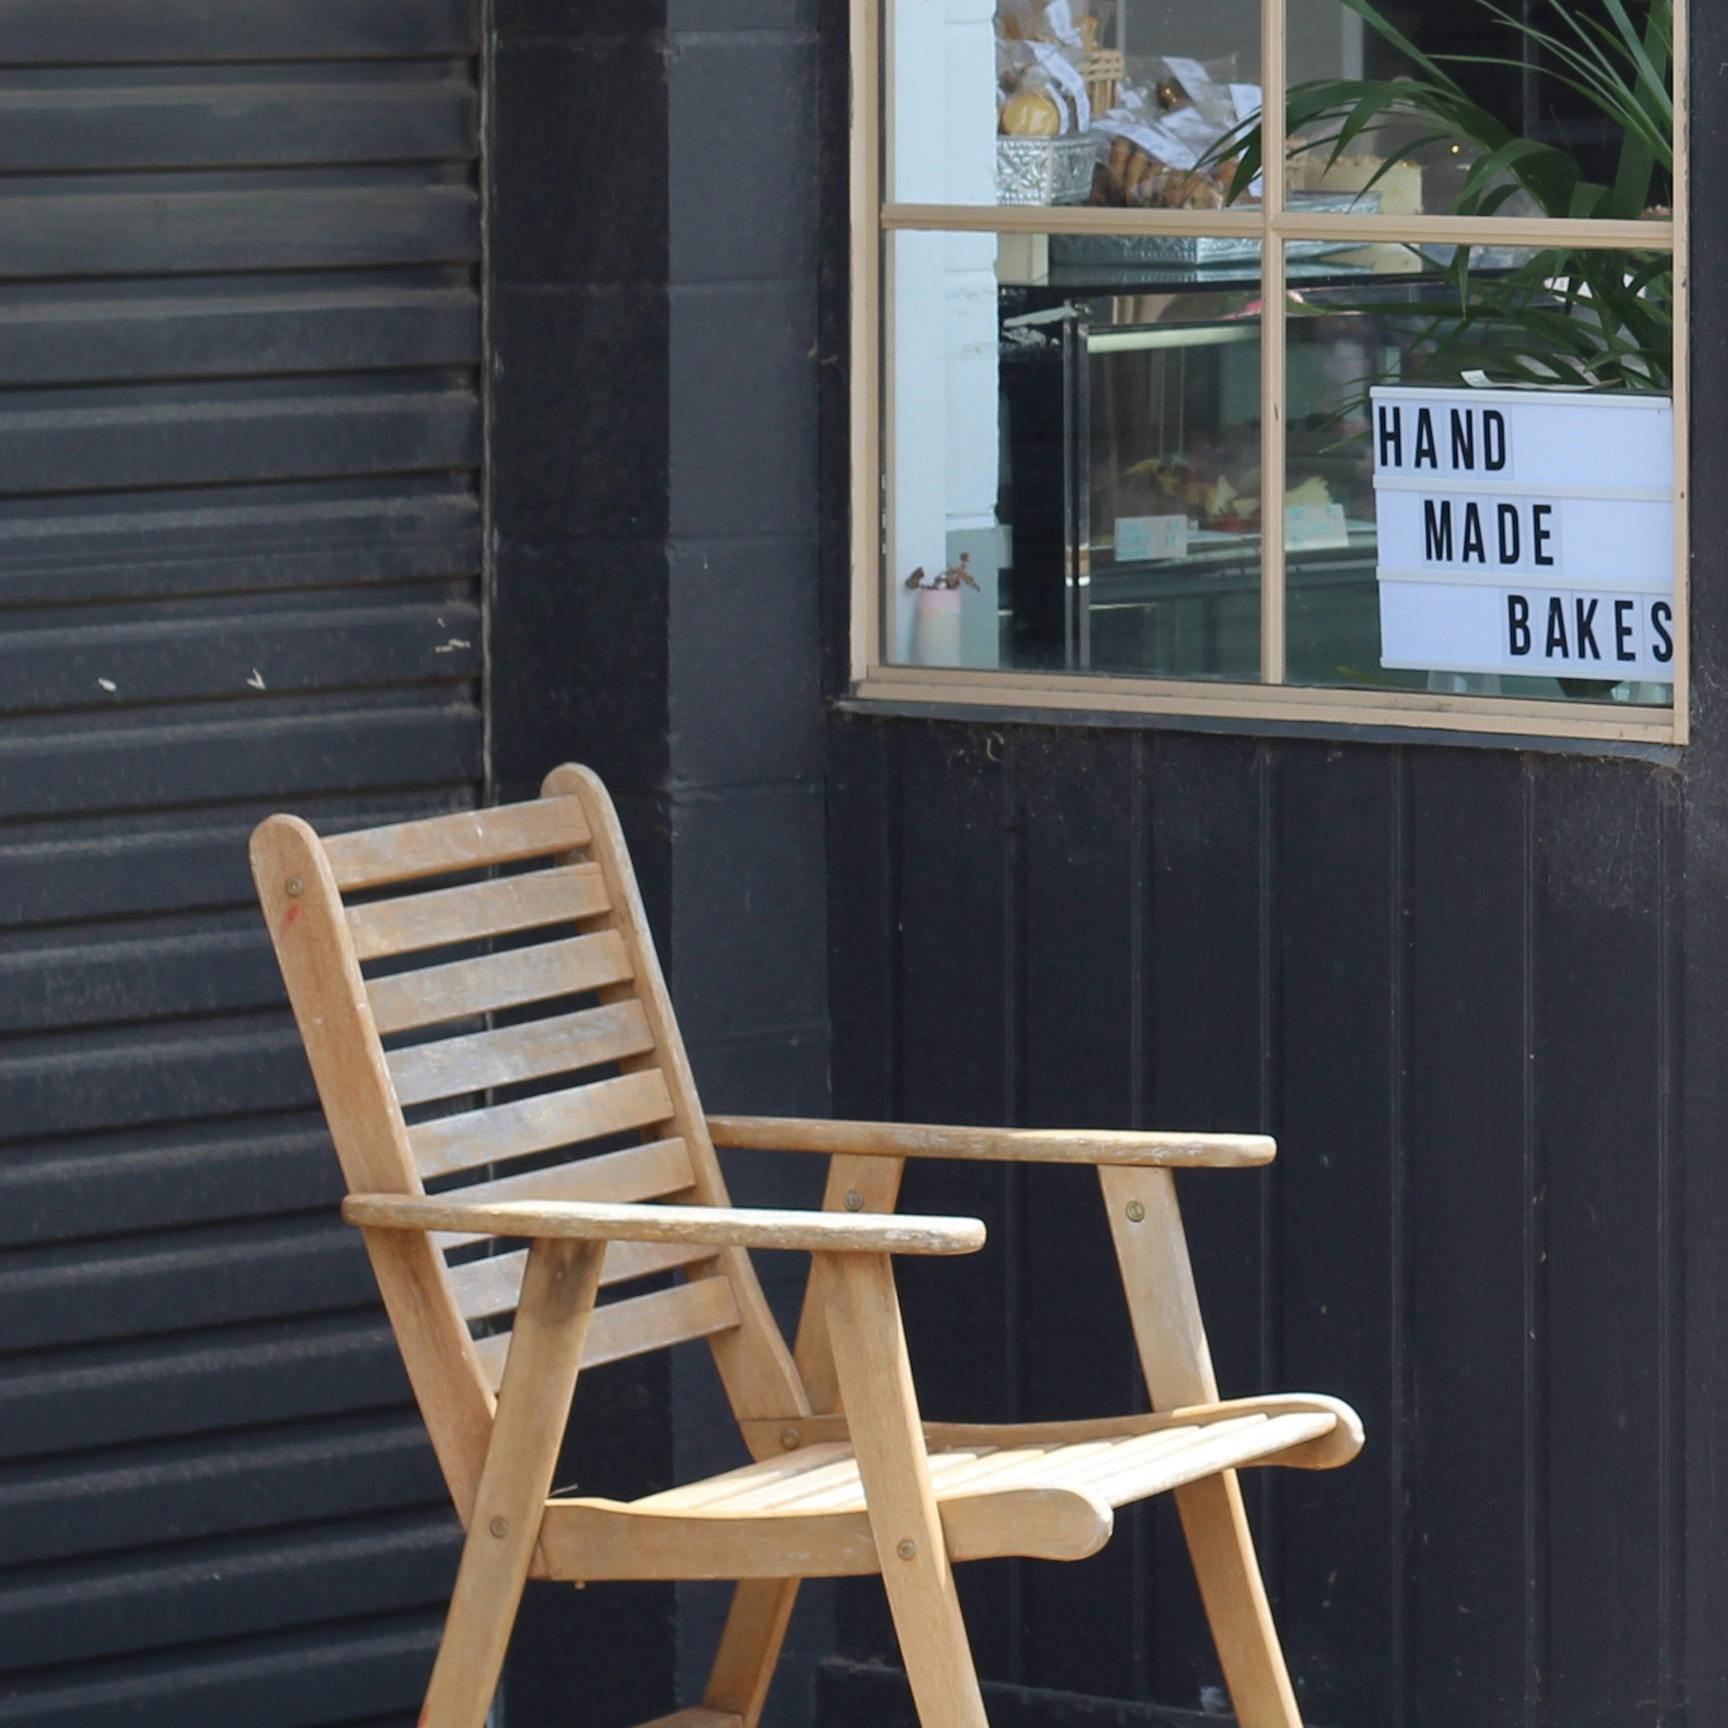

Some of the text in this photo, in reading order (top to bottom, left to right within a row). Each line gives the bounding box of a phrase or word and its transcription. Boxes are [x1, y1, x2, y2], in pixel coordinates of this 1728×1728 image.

[1379, 406, 1506, 471] HAND
[1424, 500, 1554, 565] MADE
[1508, 595, 1673, 662] BAKES
